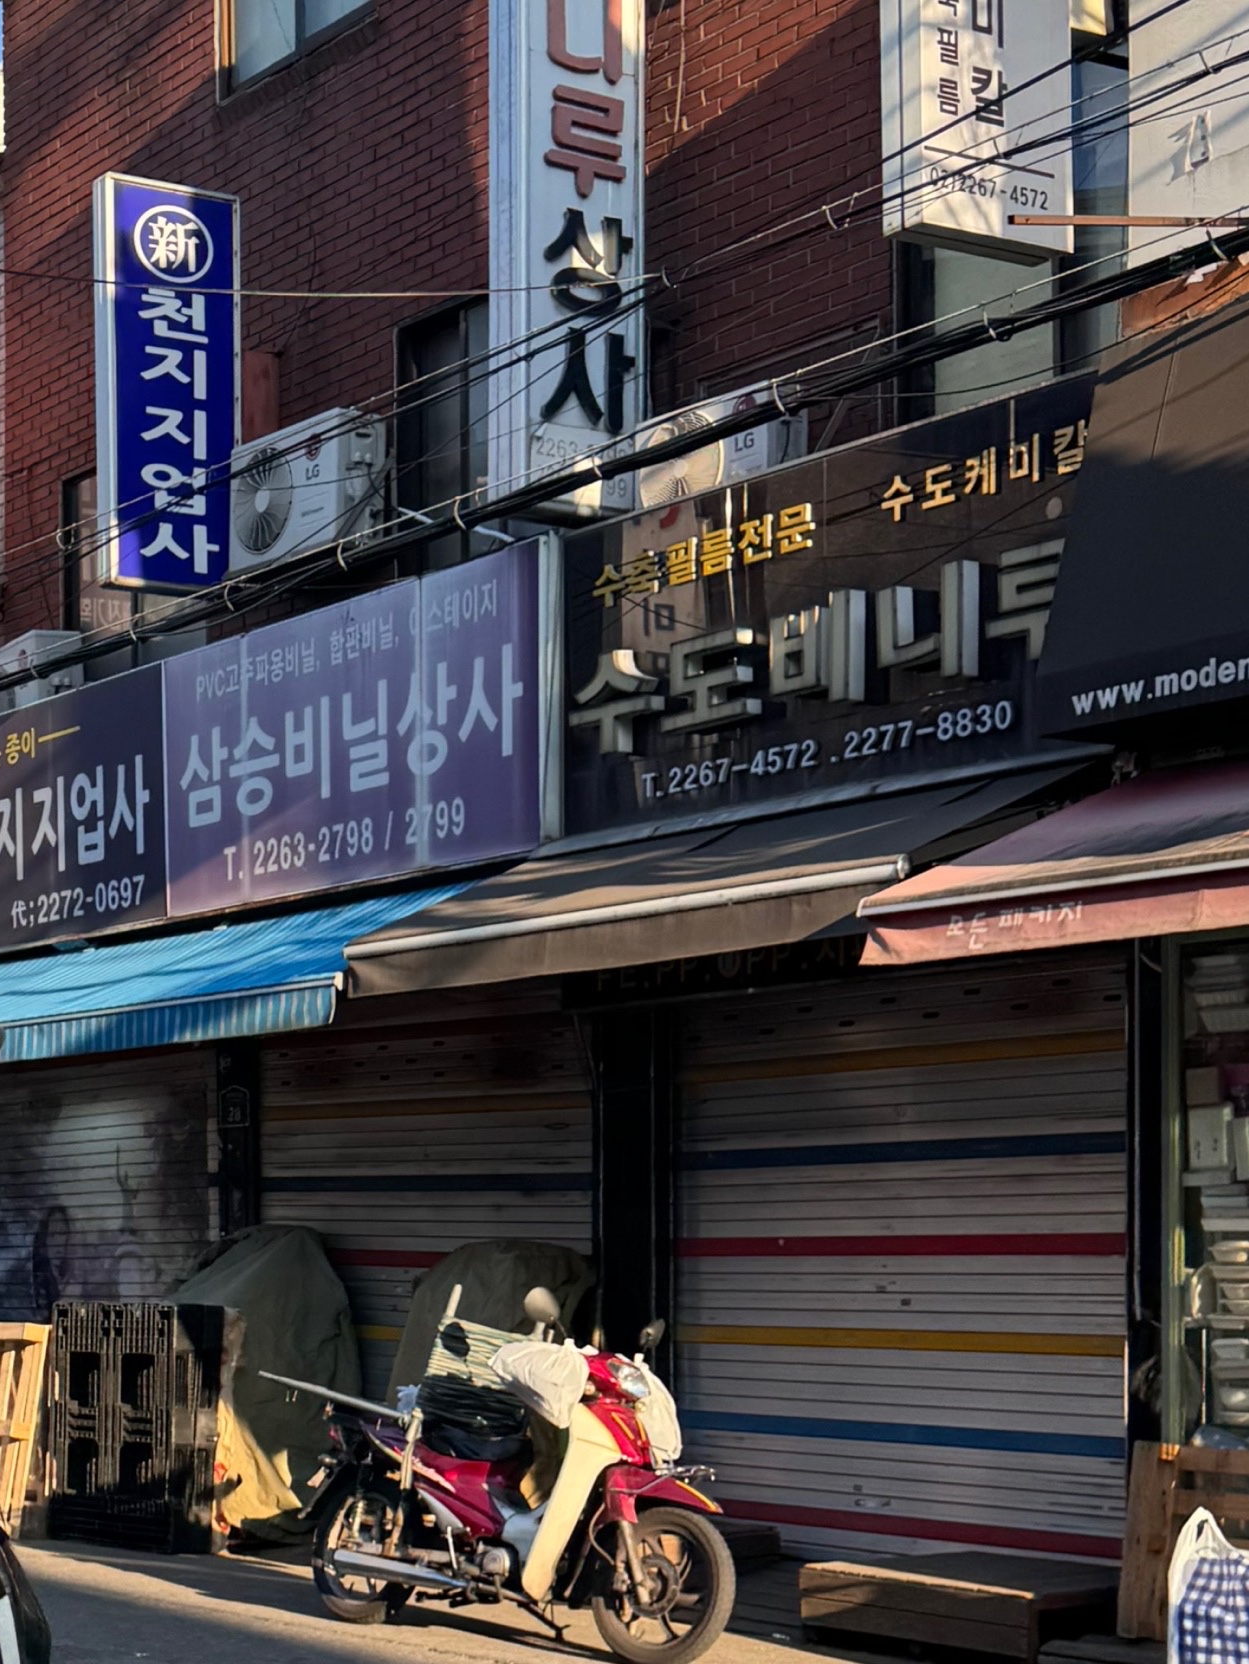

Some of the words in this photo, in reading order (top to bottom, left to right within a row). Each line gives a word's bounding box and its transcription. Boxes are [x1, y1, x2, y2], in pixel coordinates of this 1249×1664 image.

[148, 216, 200, 273] 新
[138, 288, 220, 575] 천지지업사
[734, 434, 755, 453] LG
[305, 464, 321, 481] LG
[880, 419, 1088, 523] 수도케미칼
[592, 502, 817, 607] 수축필름전문
[5, 727, 36, 766] 종이
[179, 643, 524, 829] 삼승비닐상사
[640, 738, 819, 800] T.2267-4572
[253, 816, 374, 876] 2263-2798
[404, 796, 465, 845] 2799
[945, 911, 989, 950] 모든
[998, 901, 1083, 928] 패키지
